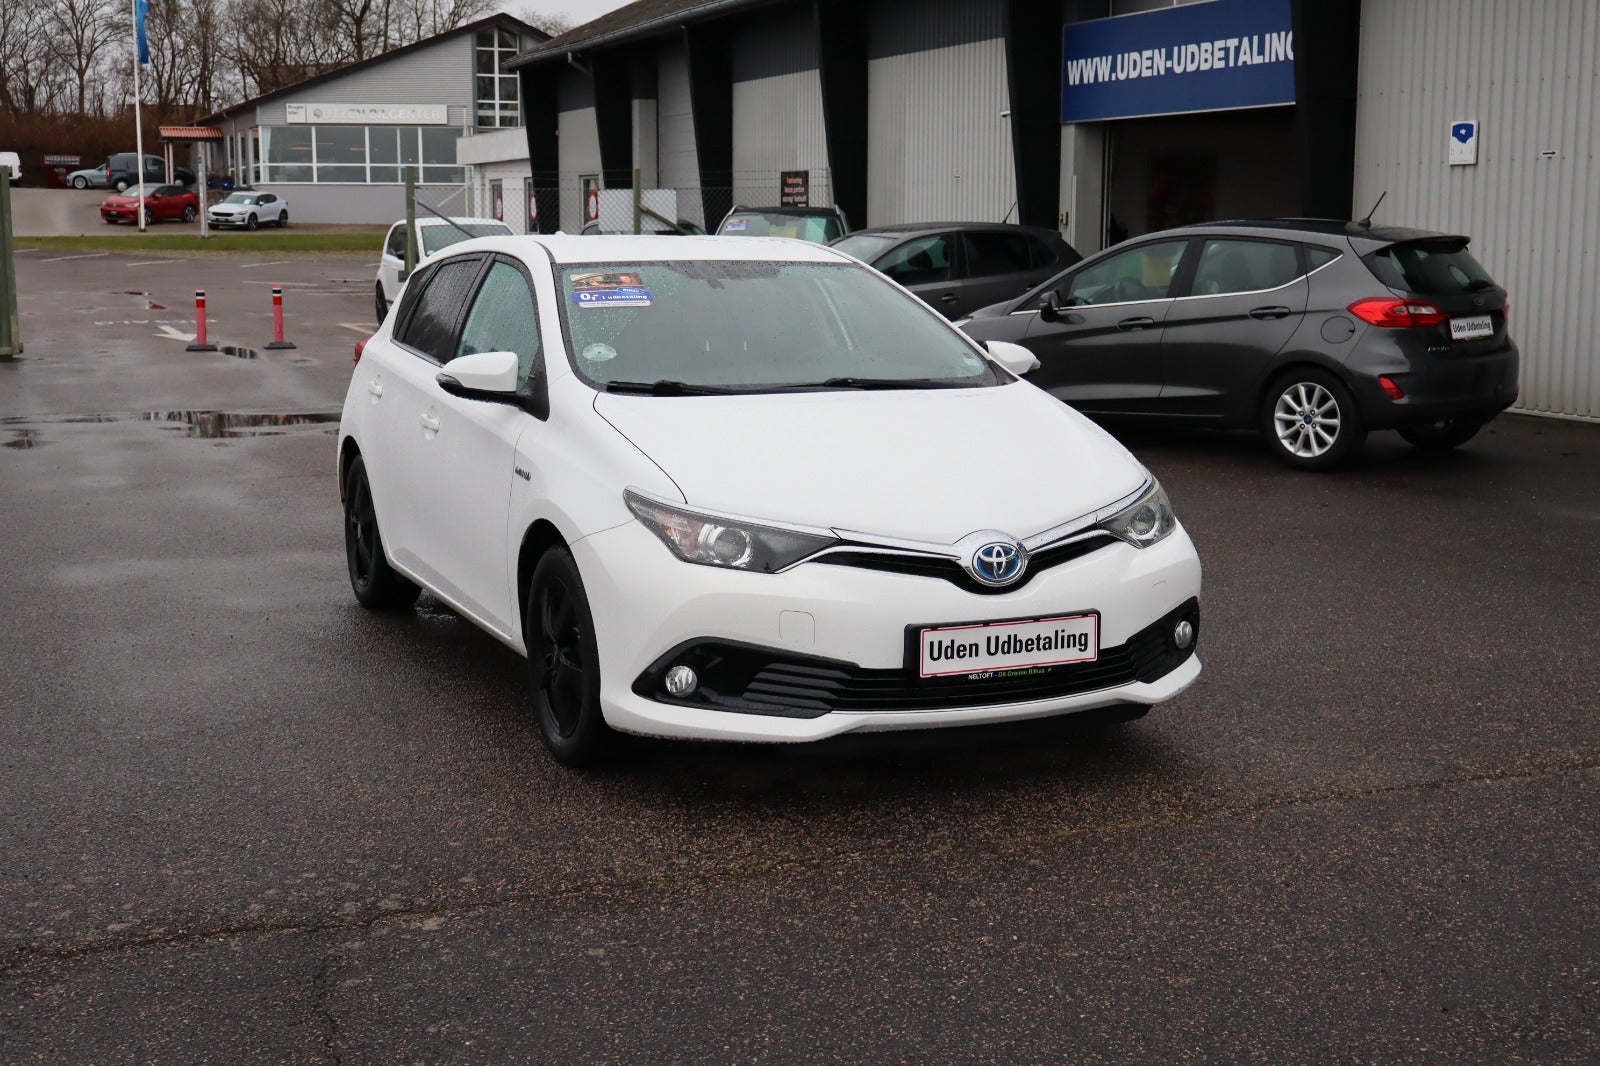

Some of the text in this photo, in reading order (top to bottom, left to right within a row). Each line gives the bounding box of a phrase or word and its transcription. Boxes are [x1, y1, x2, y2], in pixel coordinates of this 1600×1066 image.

[1452, 321, 1467, 333] Uden
[929, 629, 1089, 662] Uden Udbetaling
[968, 672, 993, 680] NELTOFT
